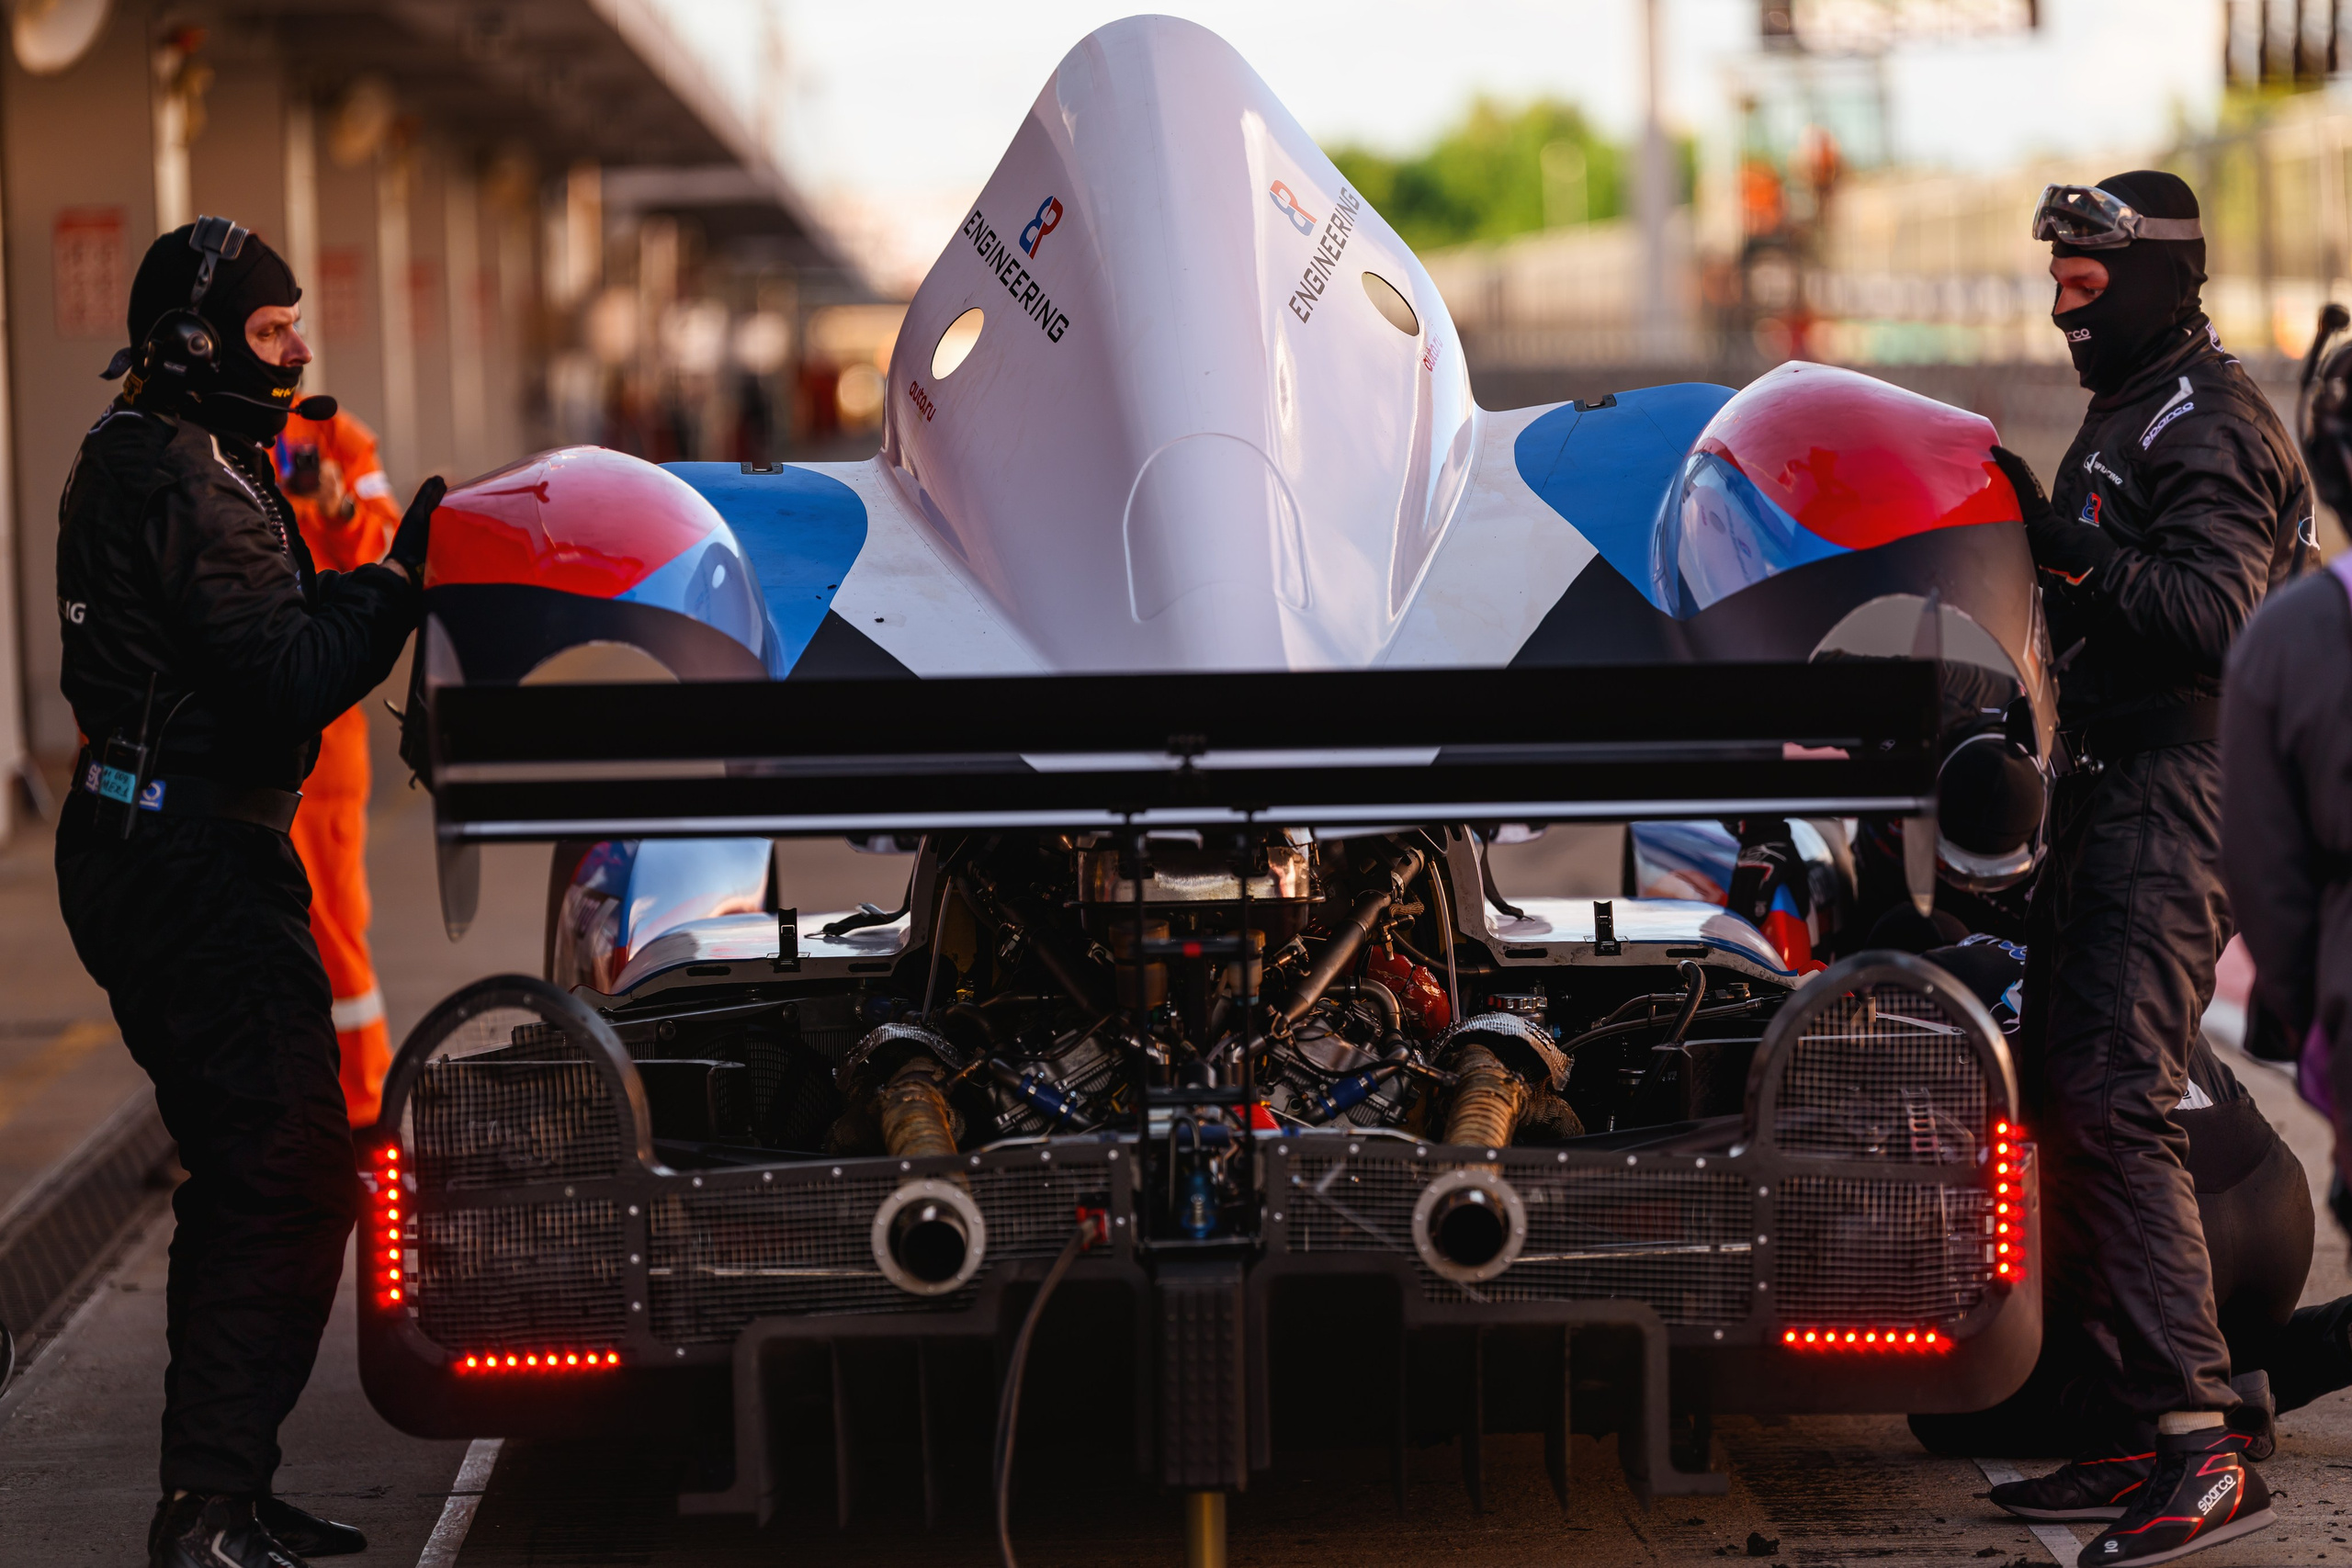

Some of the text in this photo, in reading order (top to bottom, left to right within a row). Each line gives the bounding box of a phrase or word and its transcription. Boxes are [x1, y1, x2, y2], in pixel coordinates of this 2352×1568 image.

[963, 209, 1070, 344] ENGINEERING
[1288, 186, 1361, 324] ENGINEERING
[2066, 328, 2091, 342] rco
[909, 380, 936, 423] auto.ru
[2142, 401, 2195, 451] sparco
[2197, 1473, 2236, 1515] sparco
